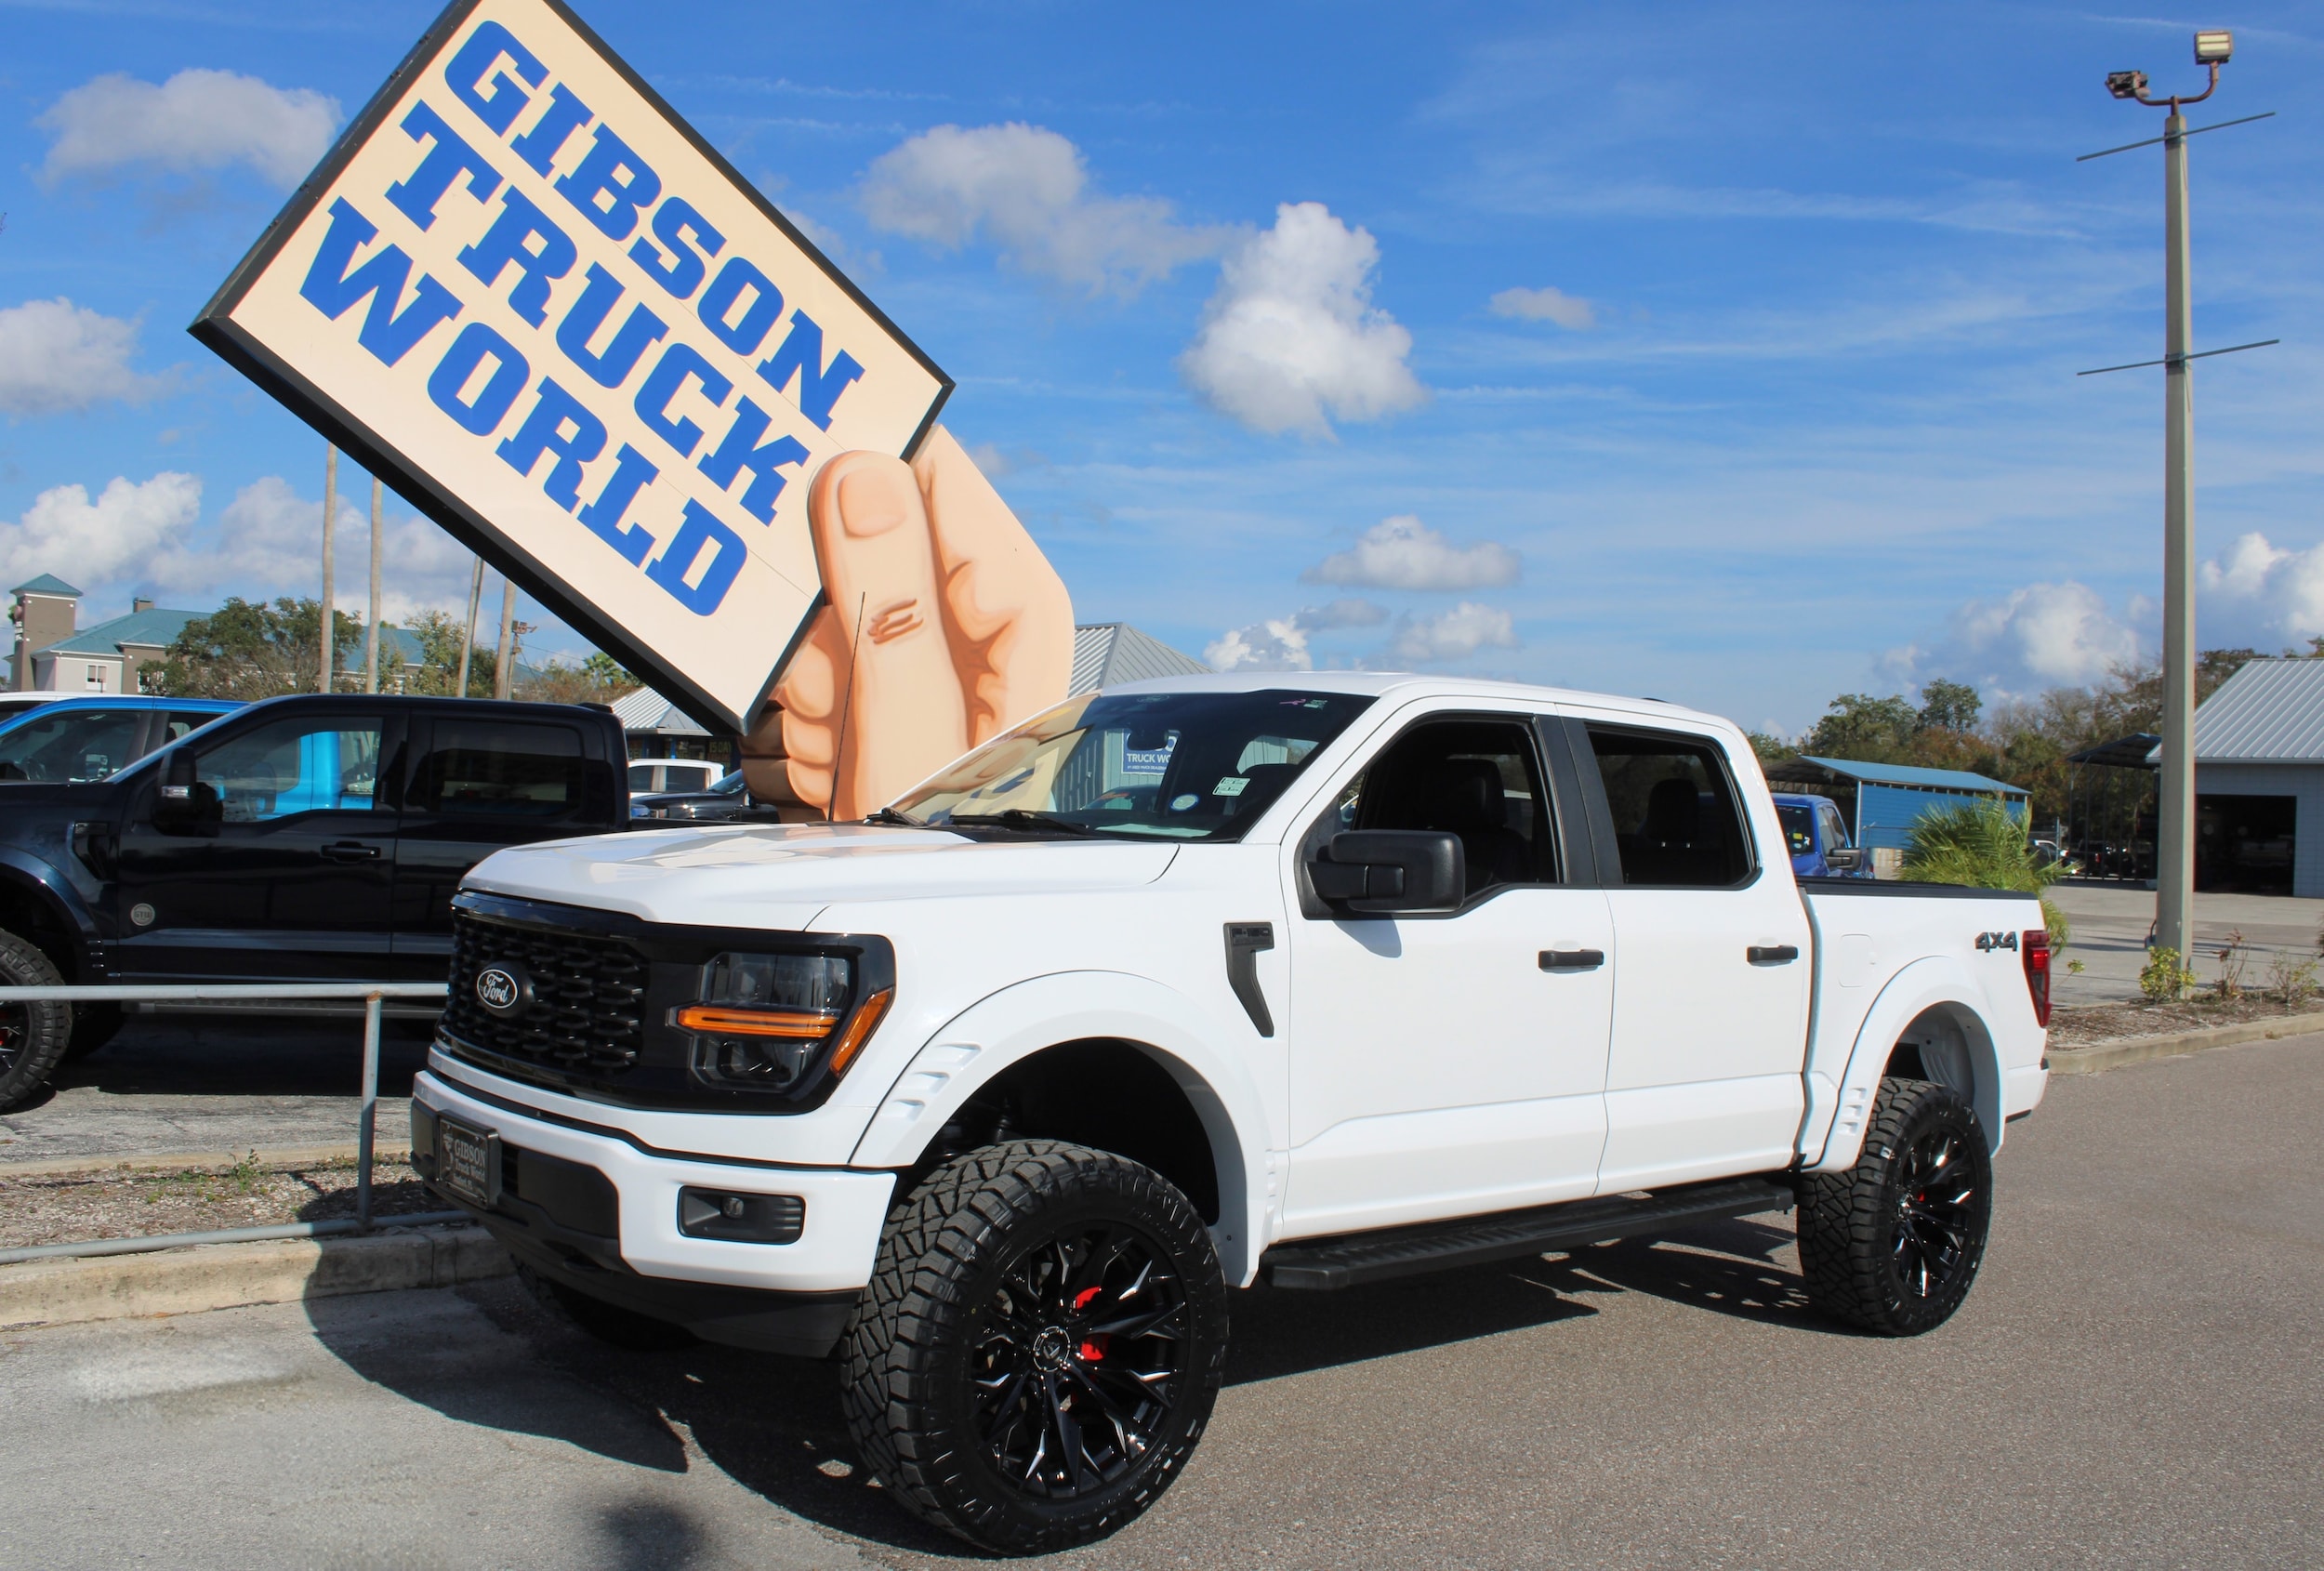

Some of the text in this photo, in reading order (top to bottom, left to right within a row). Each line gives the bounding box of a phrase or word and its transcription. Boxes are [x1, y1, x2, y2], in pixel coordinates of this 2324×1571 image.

[385, 100, 810, 526] TRUCK
[444, 20, 864, 430] GIBSON
[299, 196, 747, 616] WORLD
[1127, 753, 1155, 762] TRUCK
[482, 972, 510, 1004] Ford
[454, 1139, 486, 1168] GIBSON
